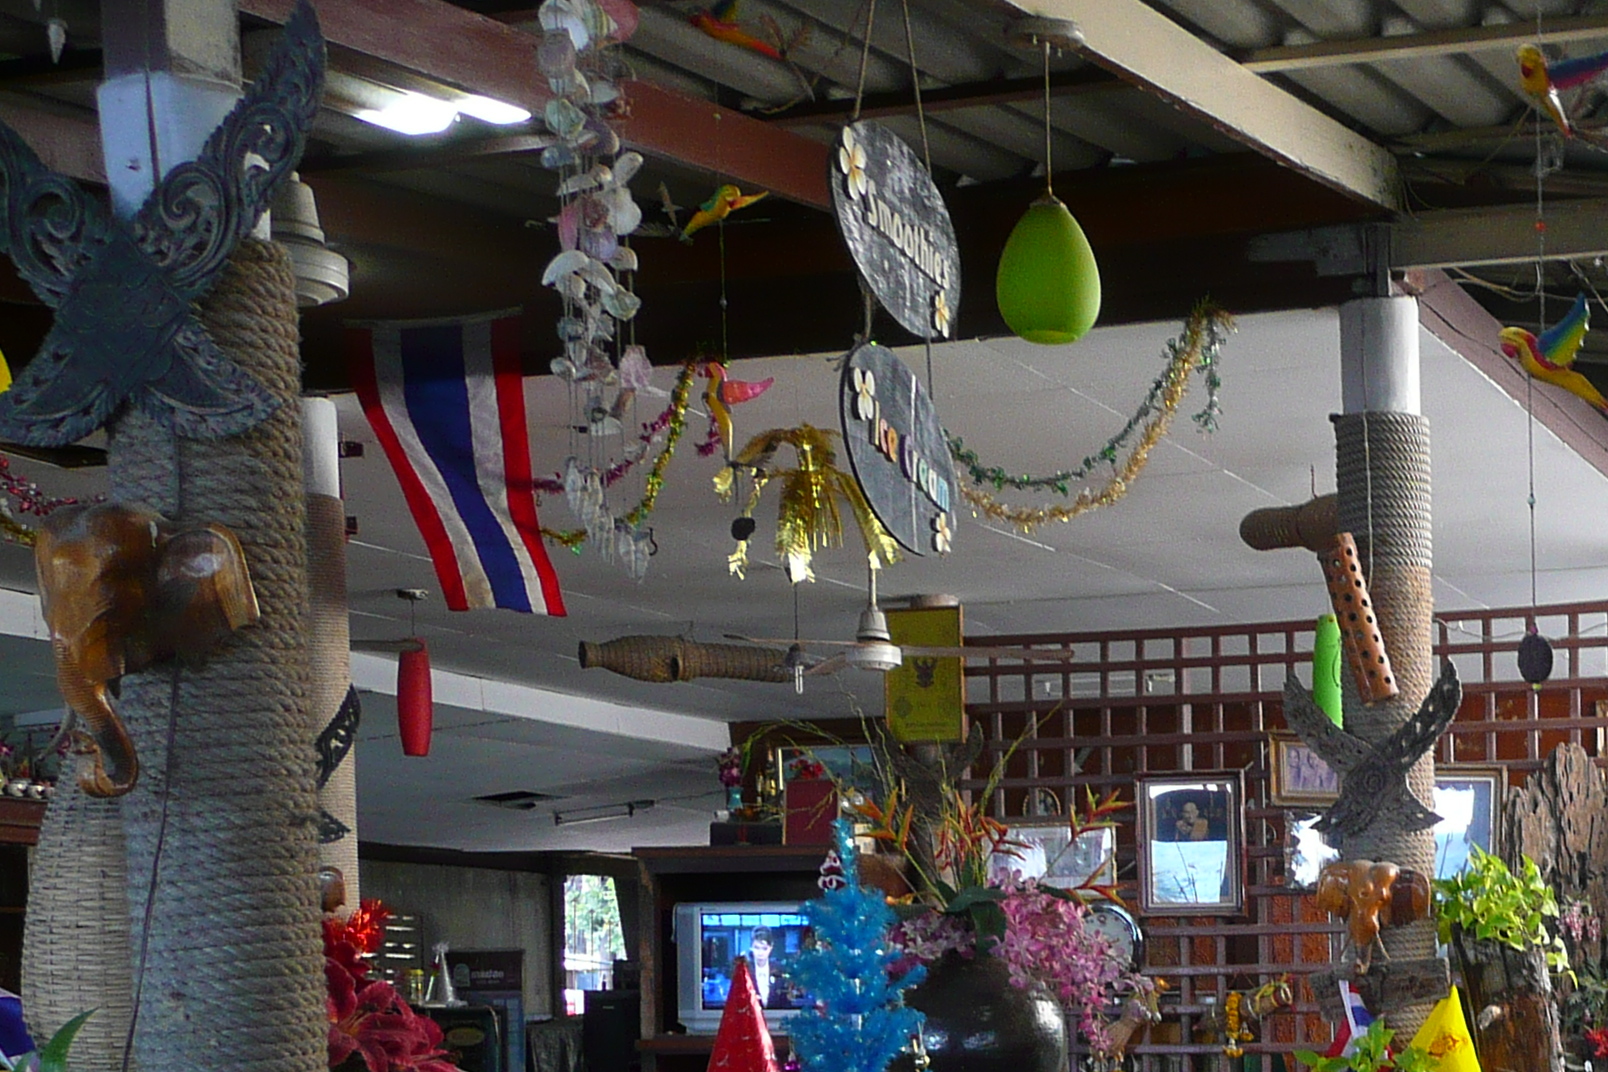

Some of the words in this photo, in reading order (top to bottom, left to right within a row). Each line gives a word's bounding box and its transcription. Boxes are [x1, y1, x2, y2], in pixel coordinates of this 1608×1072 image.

[866, 178, 950, 290] Smoothies
[875, 400, 898, 462] Ice
[903, 434, 950, 513] Cream
